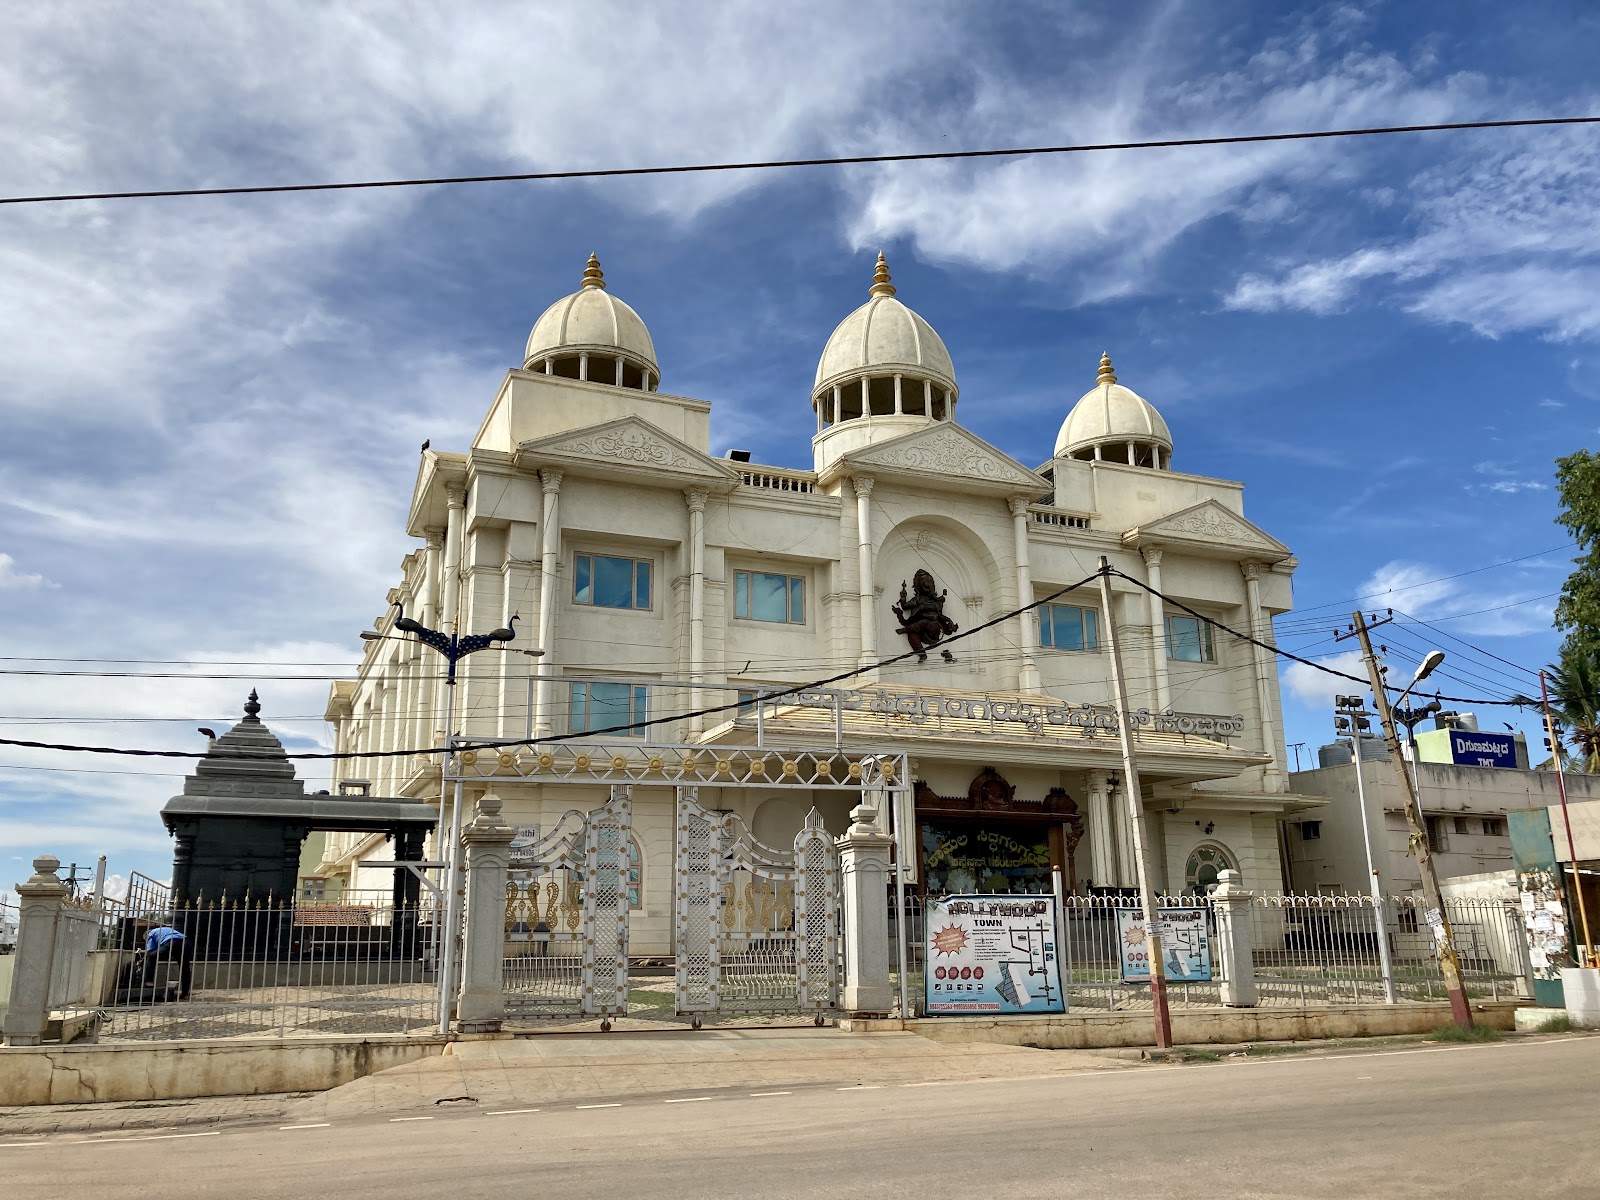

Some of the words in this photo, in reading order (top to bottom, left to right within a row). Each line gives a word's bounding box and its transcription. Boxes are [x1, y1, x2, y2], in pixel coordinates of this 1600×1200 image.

[1155, 709, 1245, 736] ಸೆಂಟರ್
[1477, 757, 1495, 767] TMT
[947, 900, 1047, 918] HOLLYWOOD
[973, 919, 1003, 927] TOWN
